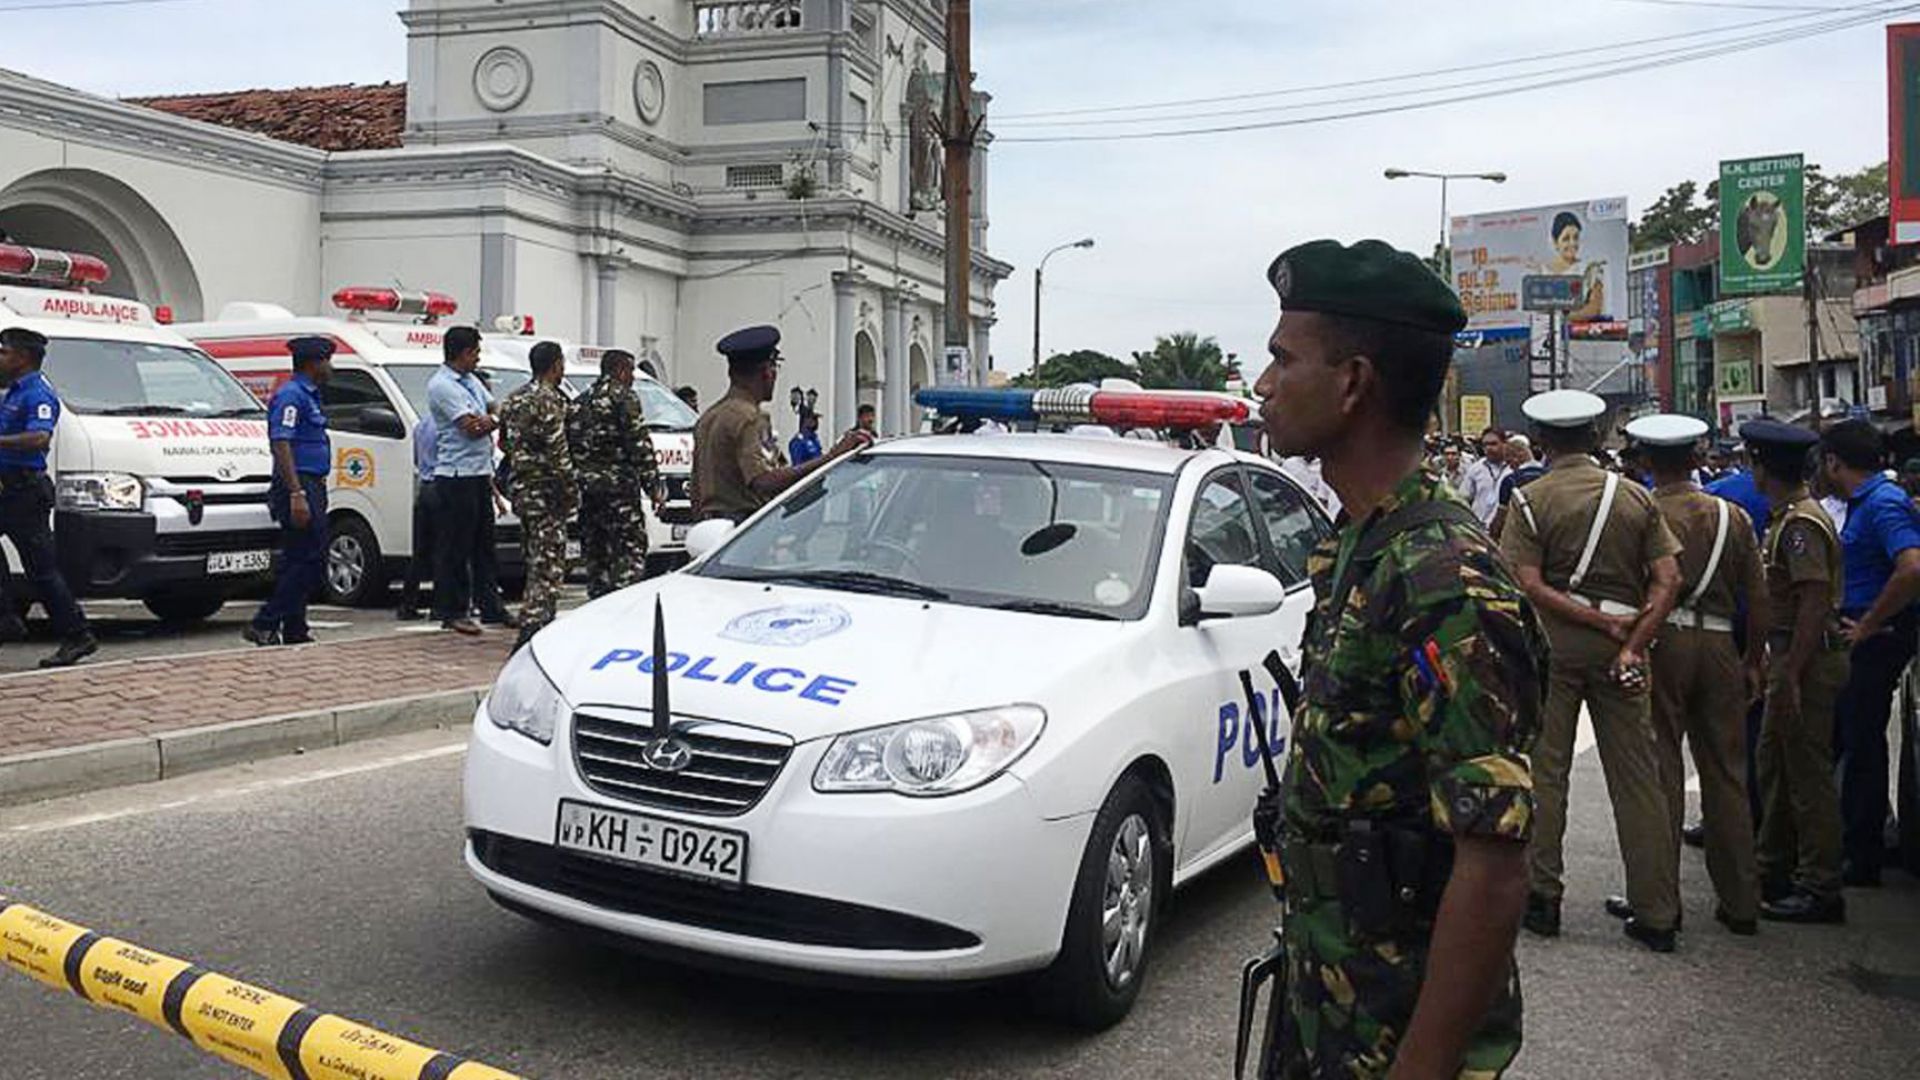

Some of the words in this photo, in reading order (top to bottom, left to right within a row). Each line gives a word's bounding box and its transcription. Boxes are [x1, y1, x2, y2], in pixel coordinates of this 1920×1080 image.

[1748, 157, 1800, 173] BETTING
[1738, 175, 1786, 189] CENTER
[43, 298, 139, 320] AMBULANCE
[163, 447, 225, 456] NAWALOKA
[226, 447, 269, 457] HOSPITAL
[591, 649, 857, 706] POLICE
[1213, 687, 1286, 784] POL
[588, 812, 628, 852] KH
[661, 827, 740, 875] 0942
[226, 985, 271, 1005] SCENE
[227, 1013, 256, 1032] ENTER
